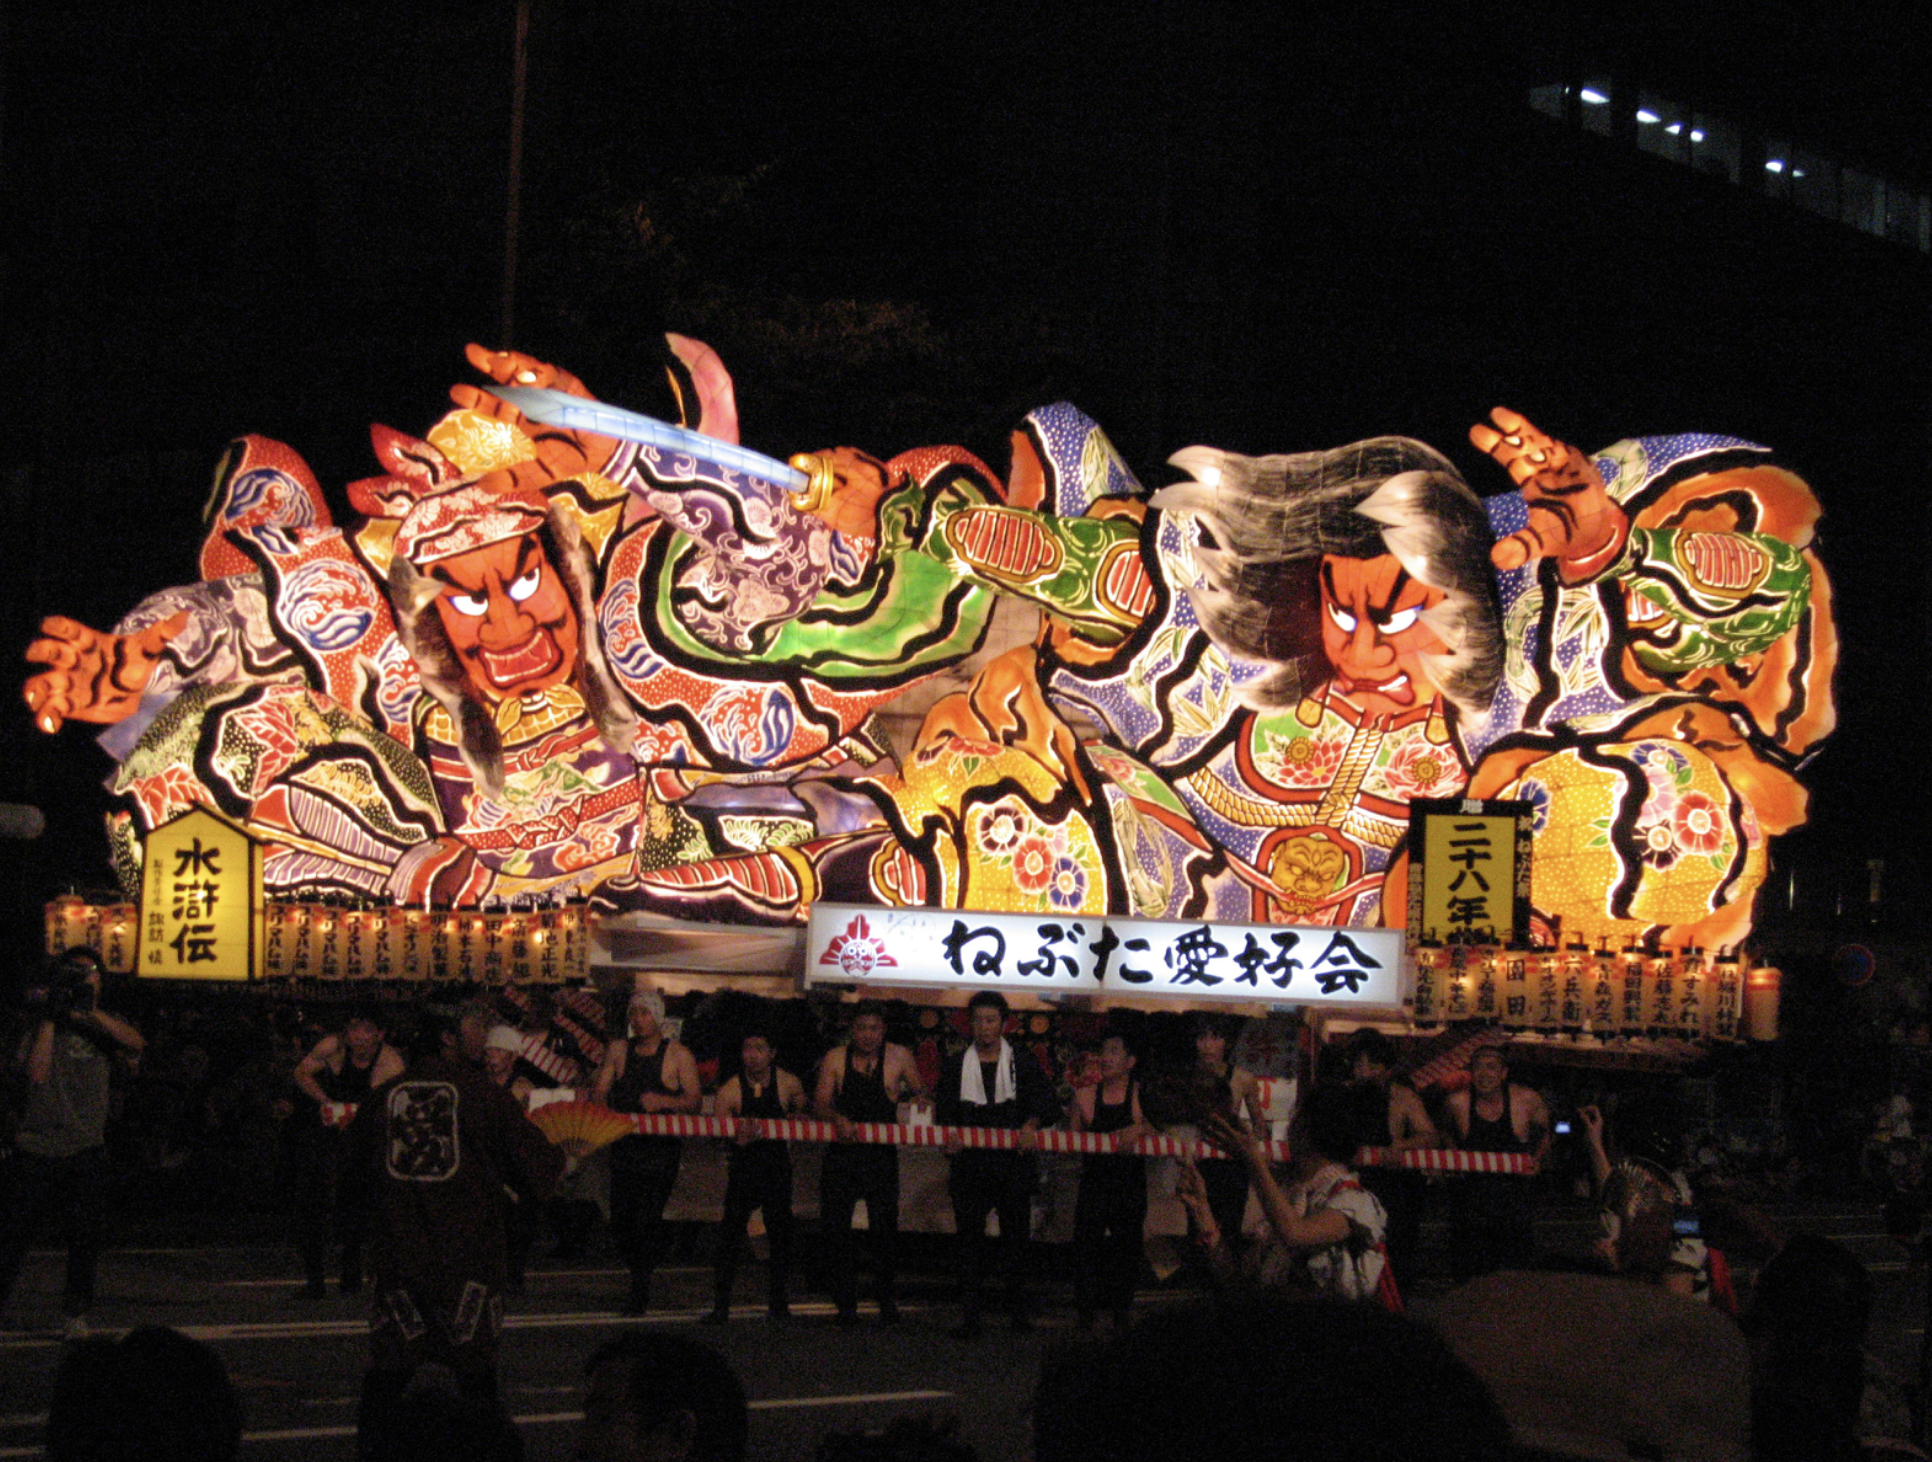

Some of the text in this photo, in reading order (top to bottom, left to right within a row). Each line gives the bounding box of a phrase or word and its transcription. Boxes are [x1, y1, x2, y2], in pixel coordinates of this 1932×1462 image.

[169, 837, 222, 965] 水滸伝
[941, 919, 1383, 995] ねぶた愛好会
[1506, 959, 1525, 1016] 園田
